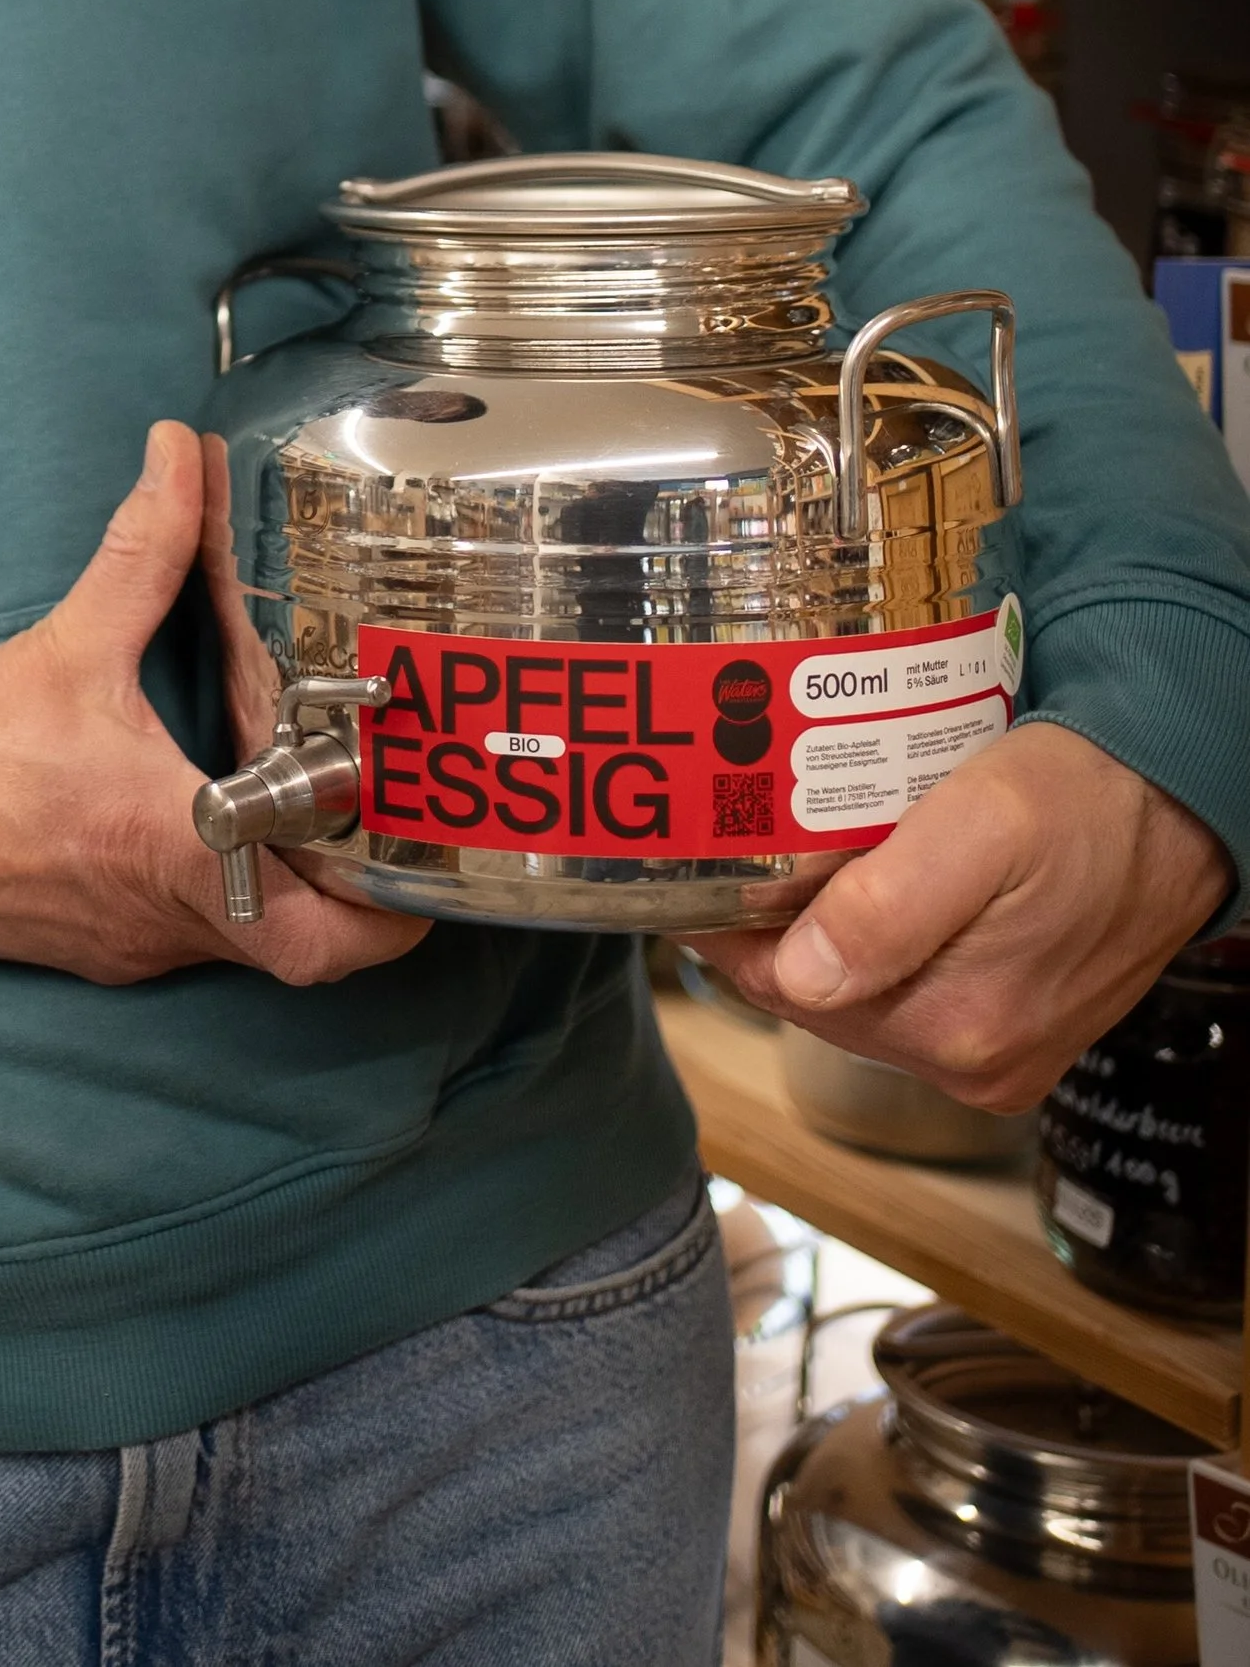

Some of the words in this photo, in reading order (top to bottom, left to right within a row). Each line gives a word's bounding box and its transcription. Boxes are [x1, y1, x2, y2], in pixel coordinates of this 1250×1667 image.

[906, 662, 921, 675] mit
[922, 659, 949, 673] Mutter
[924, 673, 949, 687] Säure
[371, 645, 695, 746] APFEL
[509, 737, 541, 754] BIO
[806, 744, 835, 754] Zutaten:
[837, 738, 881, 751] Bio-Apfelsaft
[806, 754, 820, 763] von
[806, 761, 848, 772] hauseigene
[848, 756, 889, 768] Essigmutter
[371, 732, 671, 840] ESSIG
[907, 776, 917, 785] Die
[918, 772, 939, 783] Bildung
[806, 788, 820, 796] The
[821, 786, 846, 794] Waters
[847, 782, 876, 793] Distillery
